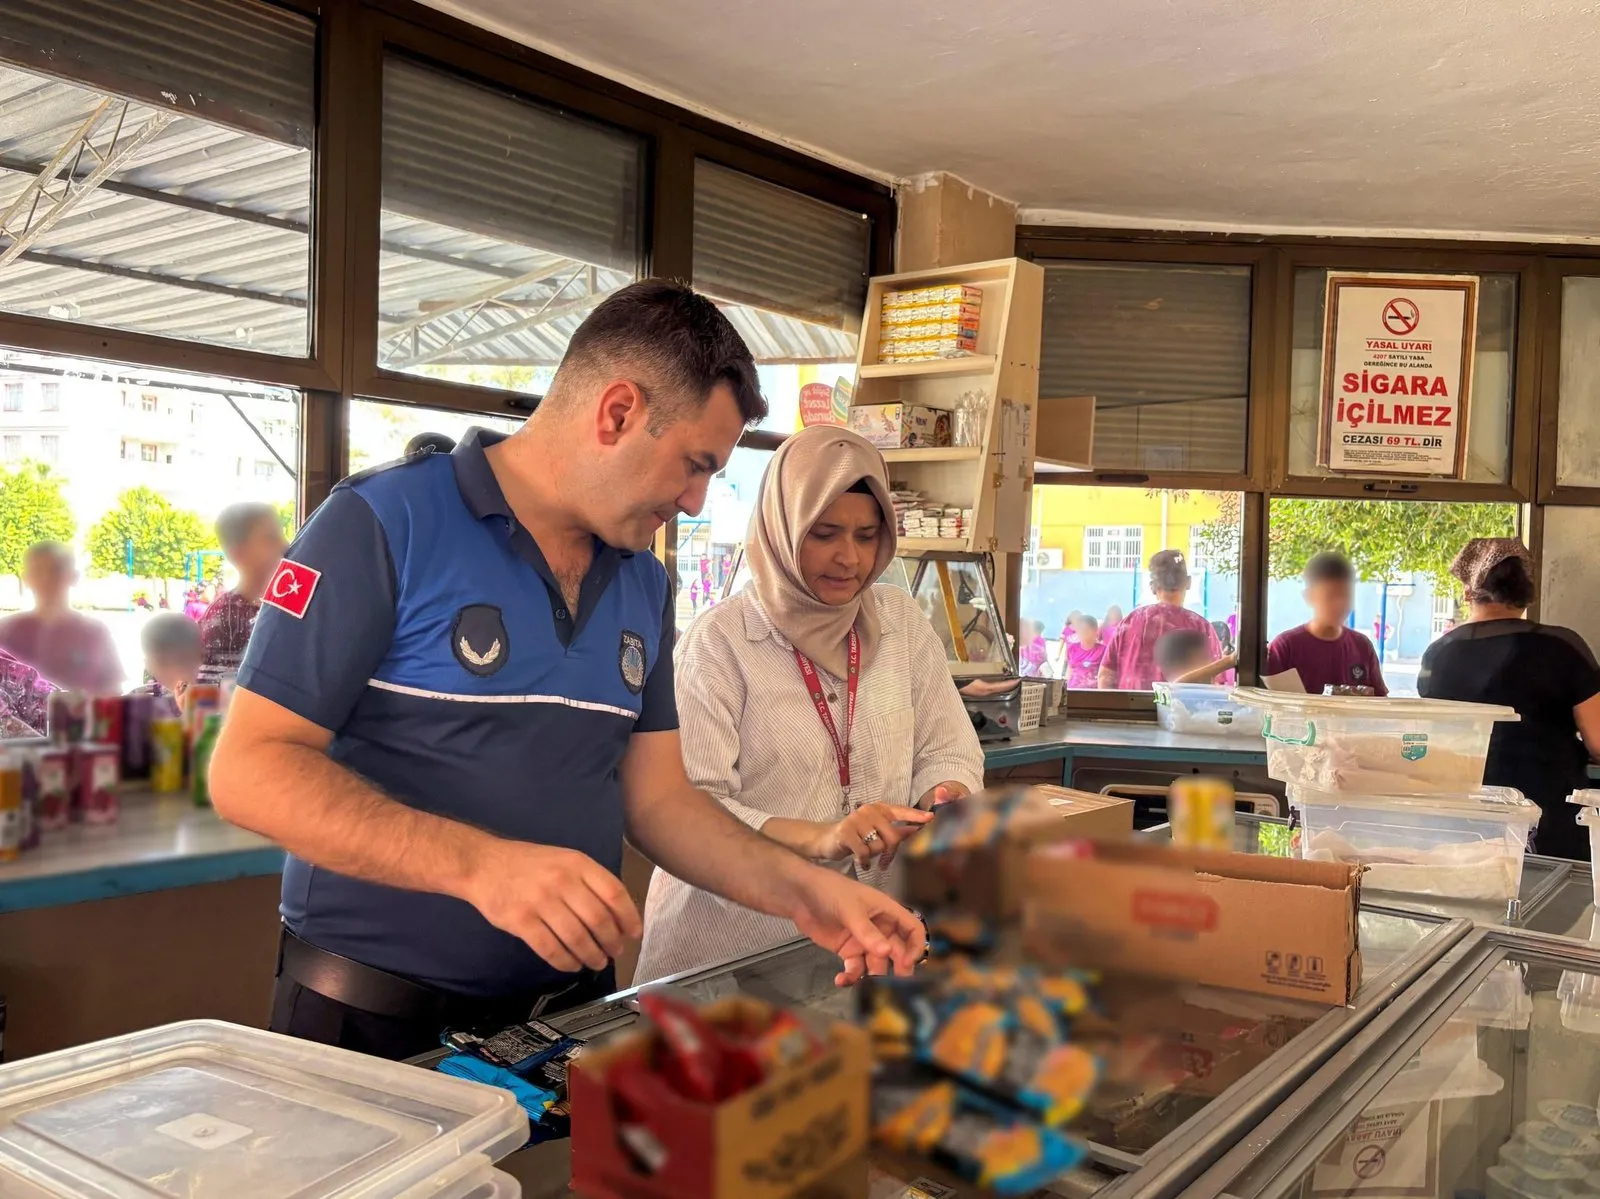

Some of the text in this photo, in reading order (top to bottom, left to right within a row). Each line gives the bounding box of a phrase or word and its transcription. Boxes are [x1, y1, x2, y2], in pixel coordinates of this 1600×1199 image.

[1366, 340, 1432, 351] YASAL UYARI
[1363, 360, 1398, 368] GEREĞİNCE
[1342, 369, 1448, 397] SİGARA
[1336, 397, 1452, 428] İÇİLMEZ
[1343, 434, 1383, 445] CEZASI
[1386, 436, 1401, 446] 69
[623, 634, 643, 649] ZABITA
[817, 700, 826, 713] T.C.
